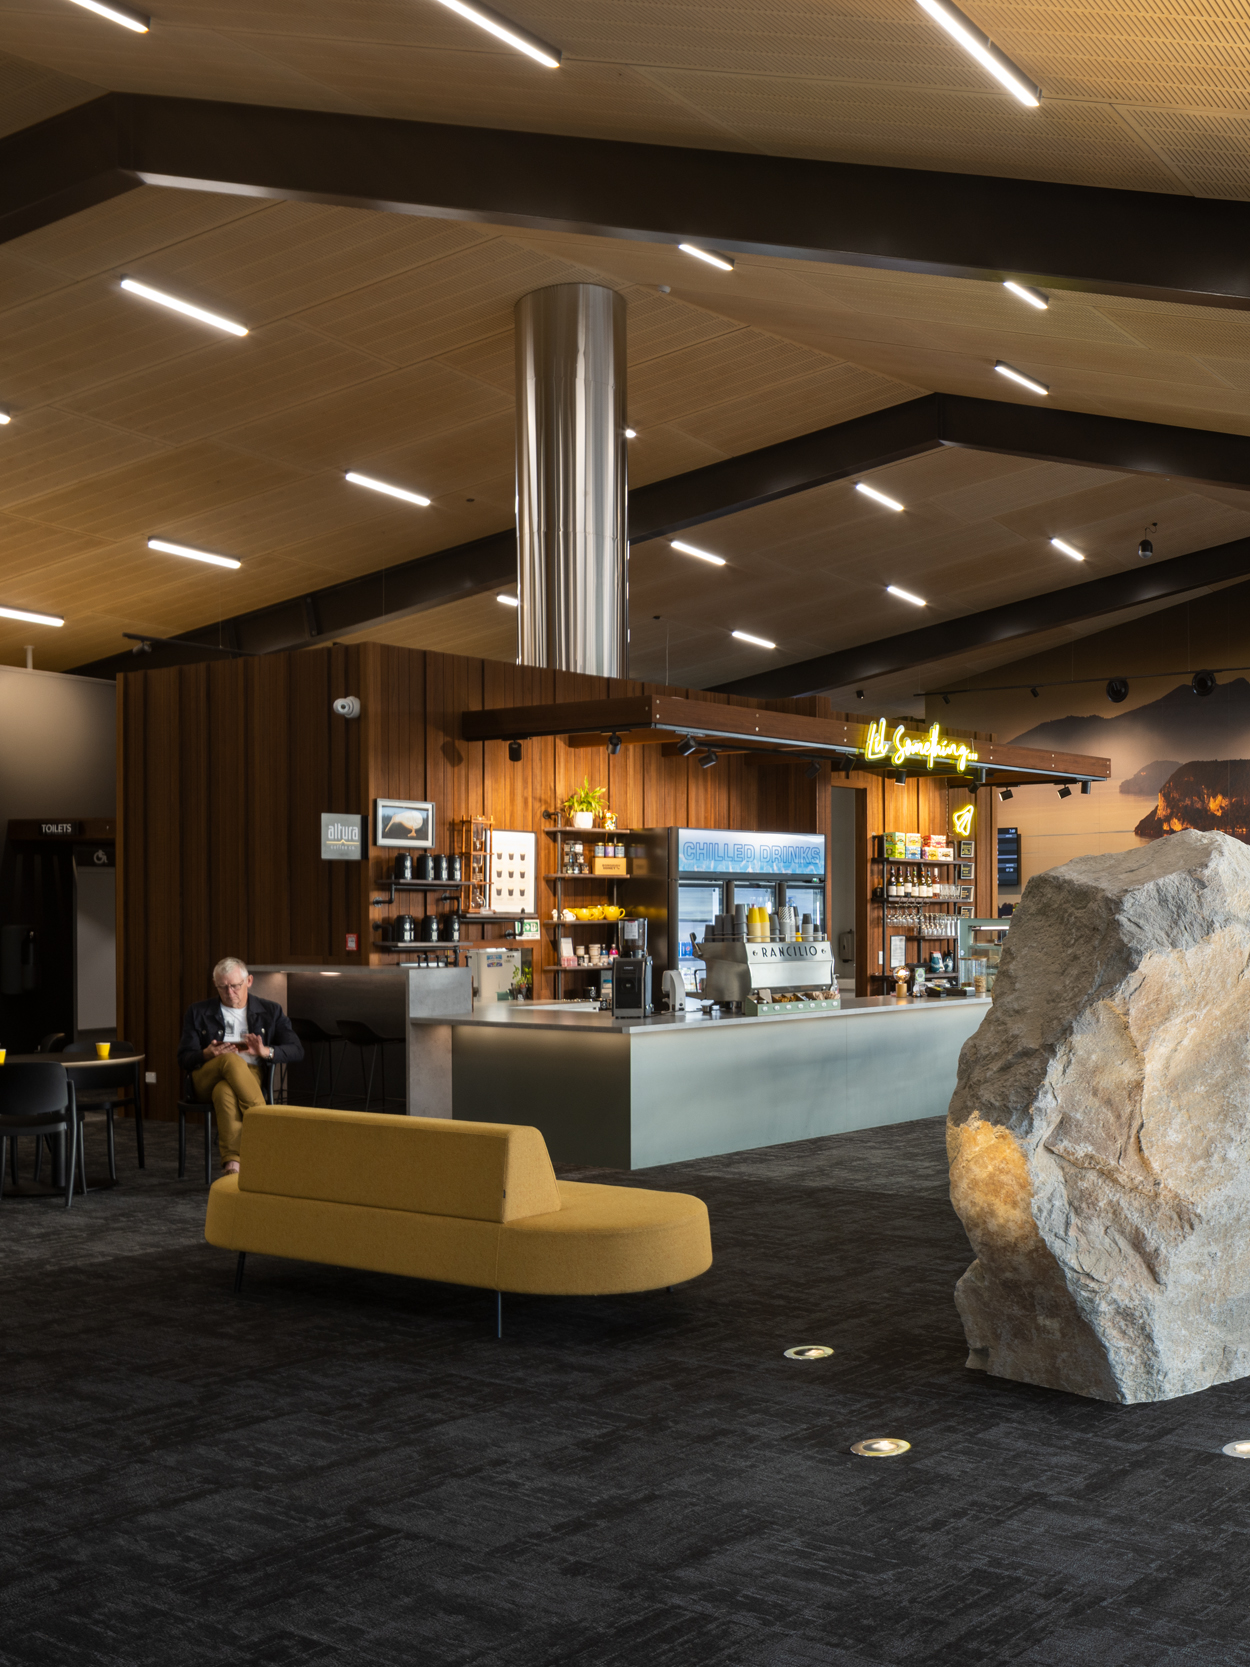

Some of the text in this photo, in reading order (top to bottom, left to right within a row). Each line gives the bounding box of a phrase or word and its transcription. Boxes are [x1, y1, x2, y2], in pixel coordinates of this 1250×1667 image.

[41, 823, 72, 834] TOILETS
[327, 822, 359, 840] altura
[683, 841, 821, 864] CHILLED DRINKS
[761, 945, 818, 958] RANCILIO
